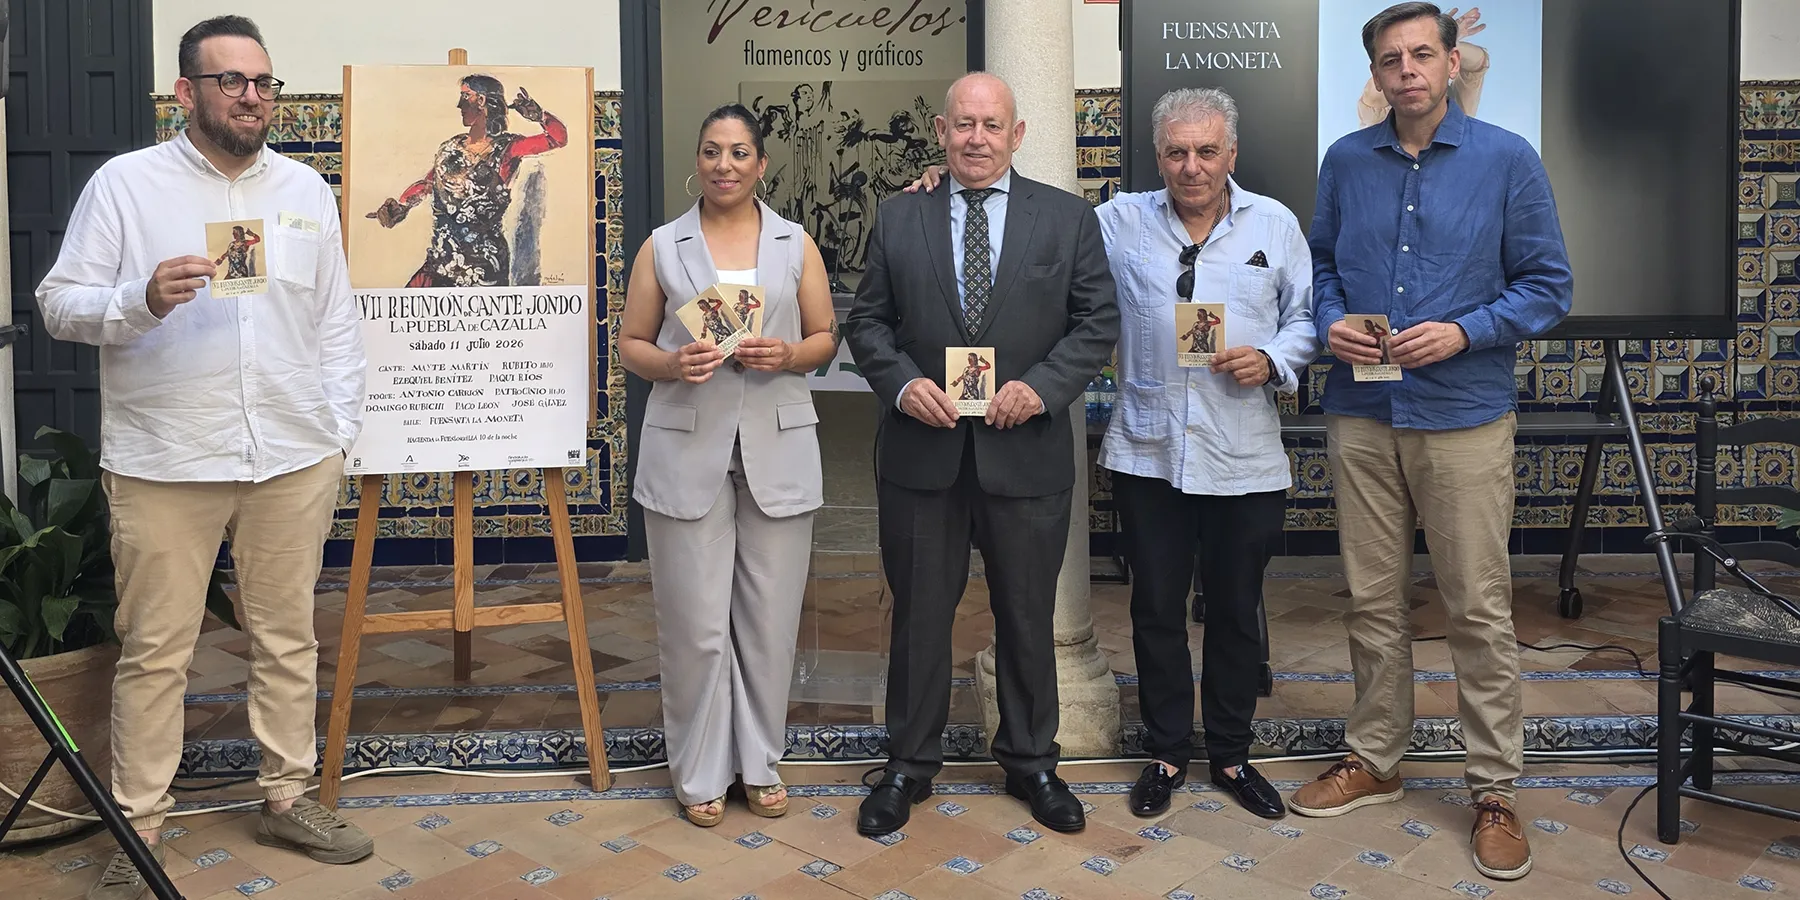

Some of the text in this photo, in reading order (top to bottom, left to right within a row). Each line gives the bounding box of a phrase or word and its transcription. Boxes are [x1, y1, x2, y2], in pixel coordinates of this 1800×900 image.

[1163, 21, 1281, 39] FUENSANTA
[744, 40, 923, 71] flamencos y gráficos
[1166, 52, 1282, 69] LA MONETA
[388, 291, 464, 319] REUNIÓN
[468, 294, 523, 317] CANTE
[526, 294, 582, 316] JONDO
[390, 318, 547, 333] LA PUEBLA DE CAZALLA
[409, 339, 446, 351] sábado
[450, 340, 460, 350] 11
[496, 339, 524, 349] 2026
[450, 361, 490, 371] MARTÍN
[502, 361, 538, 370] RUBITO
[393, 370, 543, 385] EZEQUIEL BENÍTEZ PAQUI RÍOS
[399, 389, 445, 398] ANTONIO
[365, 403, 408, 412] DOMINGO
[455, 402, 476, 410] PACO
[429, 416, 471, 425] FUENSANTA
[484, 414, 524, 423] MONETA
